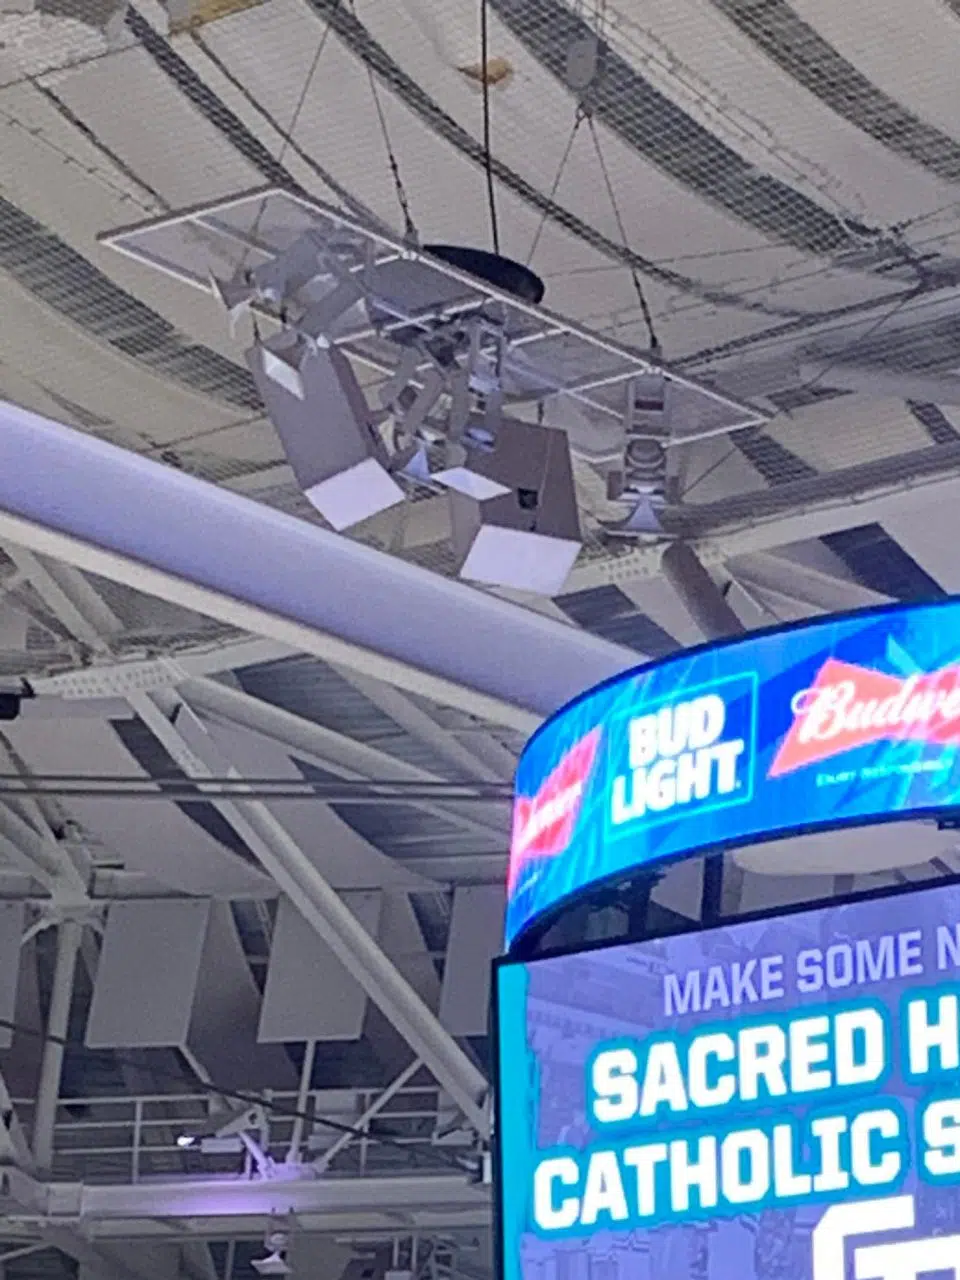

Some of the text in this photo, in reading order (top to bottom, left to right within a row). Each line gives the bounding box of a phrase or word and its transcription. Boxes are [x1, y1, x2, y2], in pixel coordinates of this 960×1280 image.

[628, 693, 726, 766] BUD
[610, 738, 744, 825] LIGHT
[663, 954, 784, 1016] MAKE
[796, 931, 924, 993] SOME
[592, 1008, 884, 1123] SACRED
[533, 1109, 901, 1230] CATHOLIC
